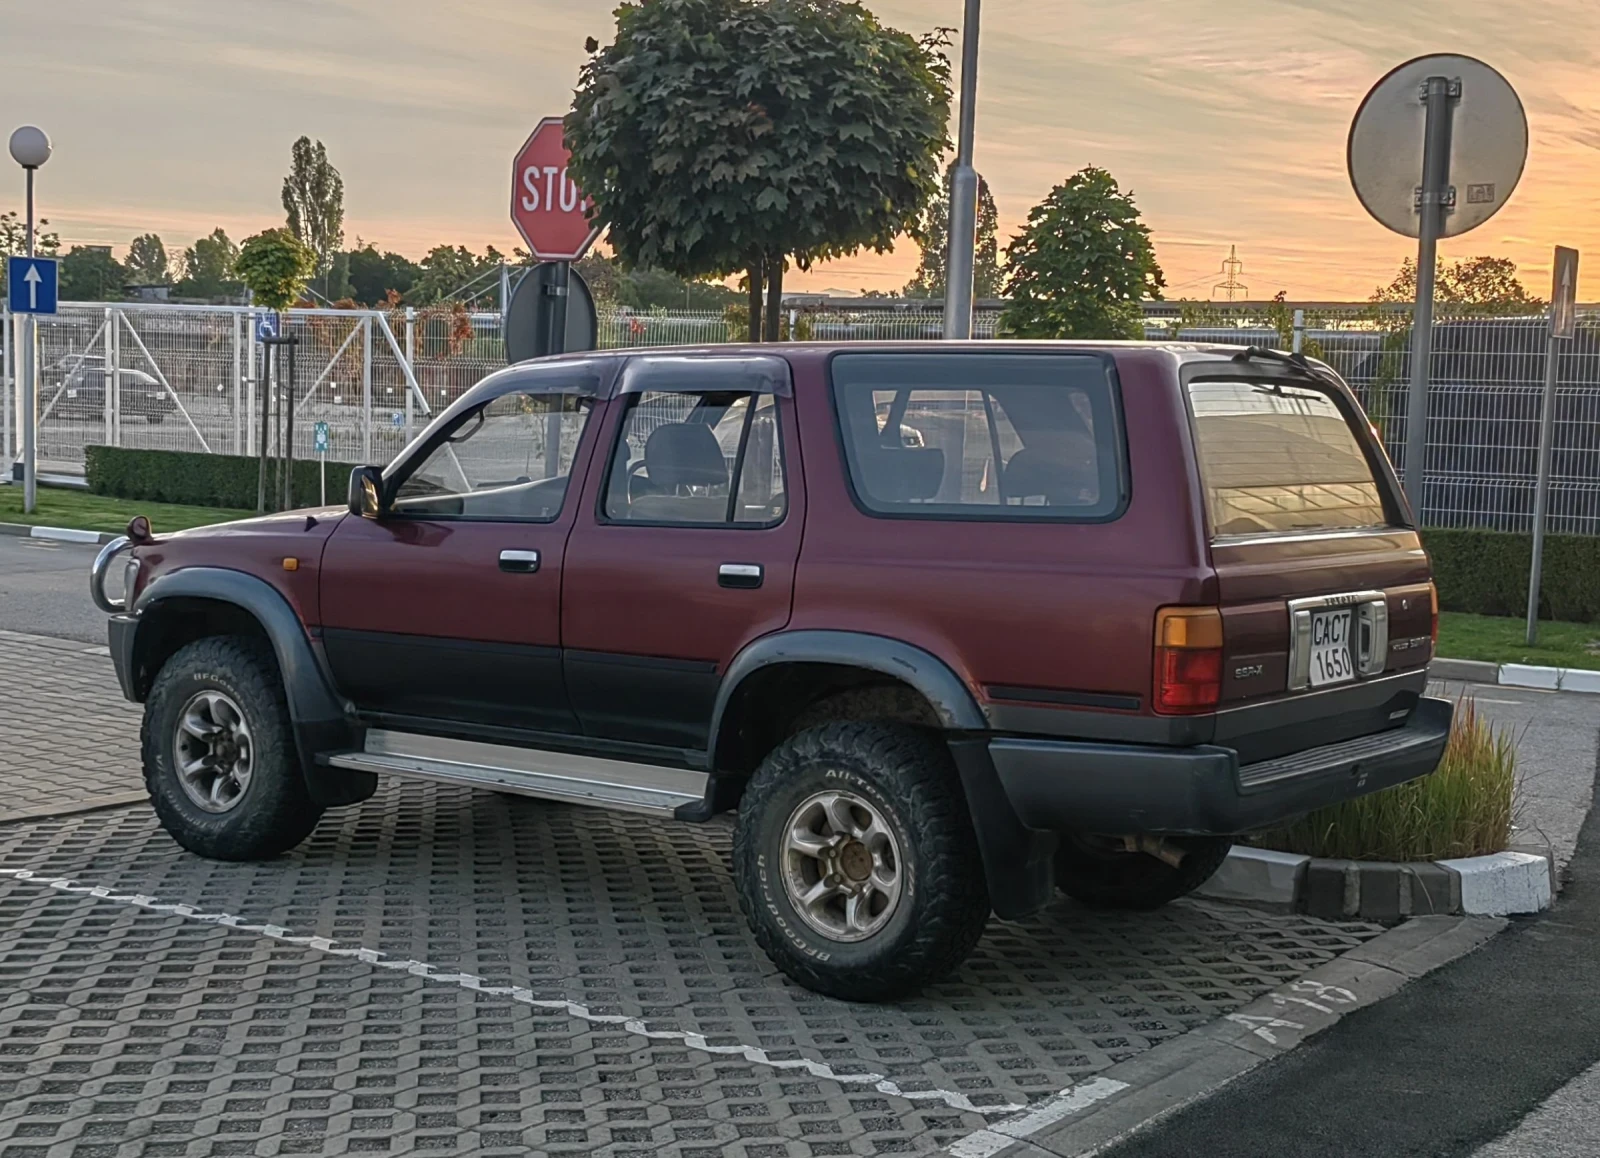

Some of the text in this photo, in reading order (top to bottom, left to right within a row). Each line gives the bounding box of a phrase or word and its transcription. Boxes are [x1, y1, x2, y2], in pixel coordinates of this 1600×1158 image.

[522, 166, 587, 212] STO
[1316, 647, 1351, 681] 1650
[757, 854, 831, 962] BFGoodrich
